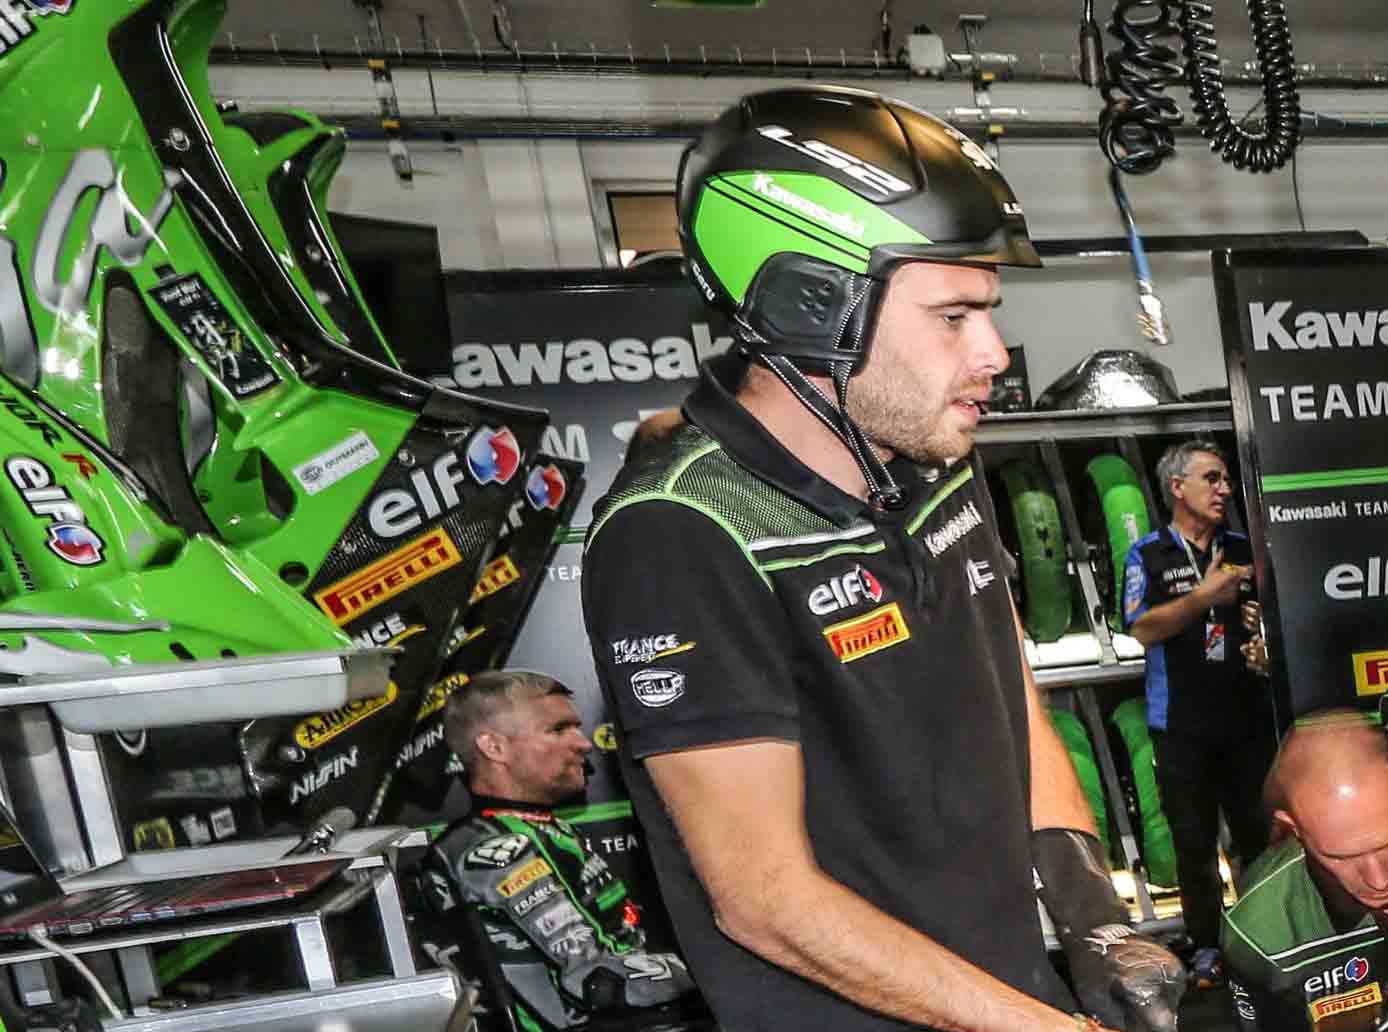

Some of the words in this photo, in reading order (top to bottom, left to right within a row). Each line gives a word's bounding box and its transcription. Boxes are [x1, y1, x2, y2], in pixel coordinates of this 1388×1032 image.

[756, 125, 912, 196] LS2
[7, 456, 85, 527] elf
[368, 455, 466, 540] elf
[1270, 501, 1347, 523] Kawasaki
[924, 500, 983, 558] Kawasaki
[321, 533, 452, 621] PIRELLI
[809, 570, 860, 616] elf
[1304, 966, 1343, 993] elf
